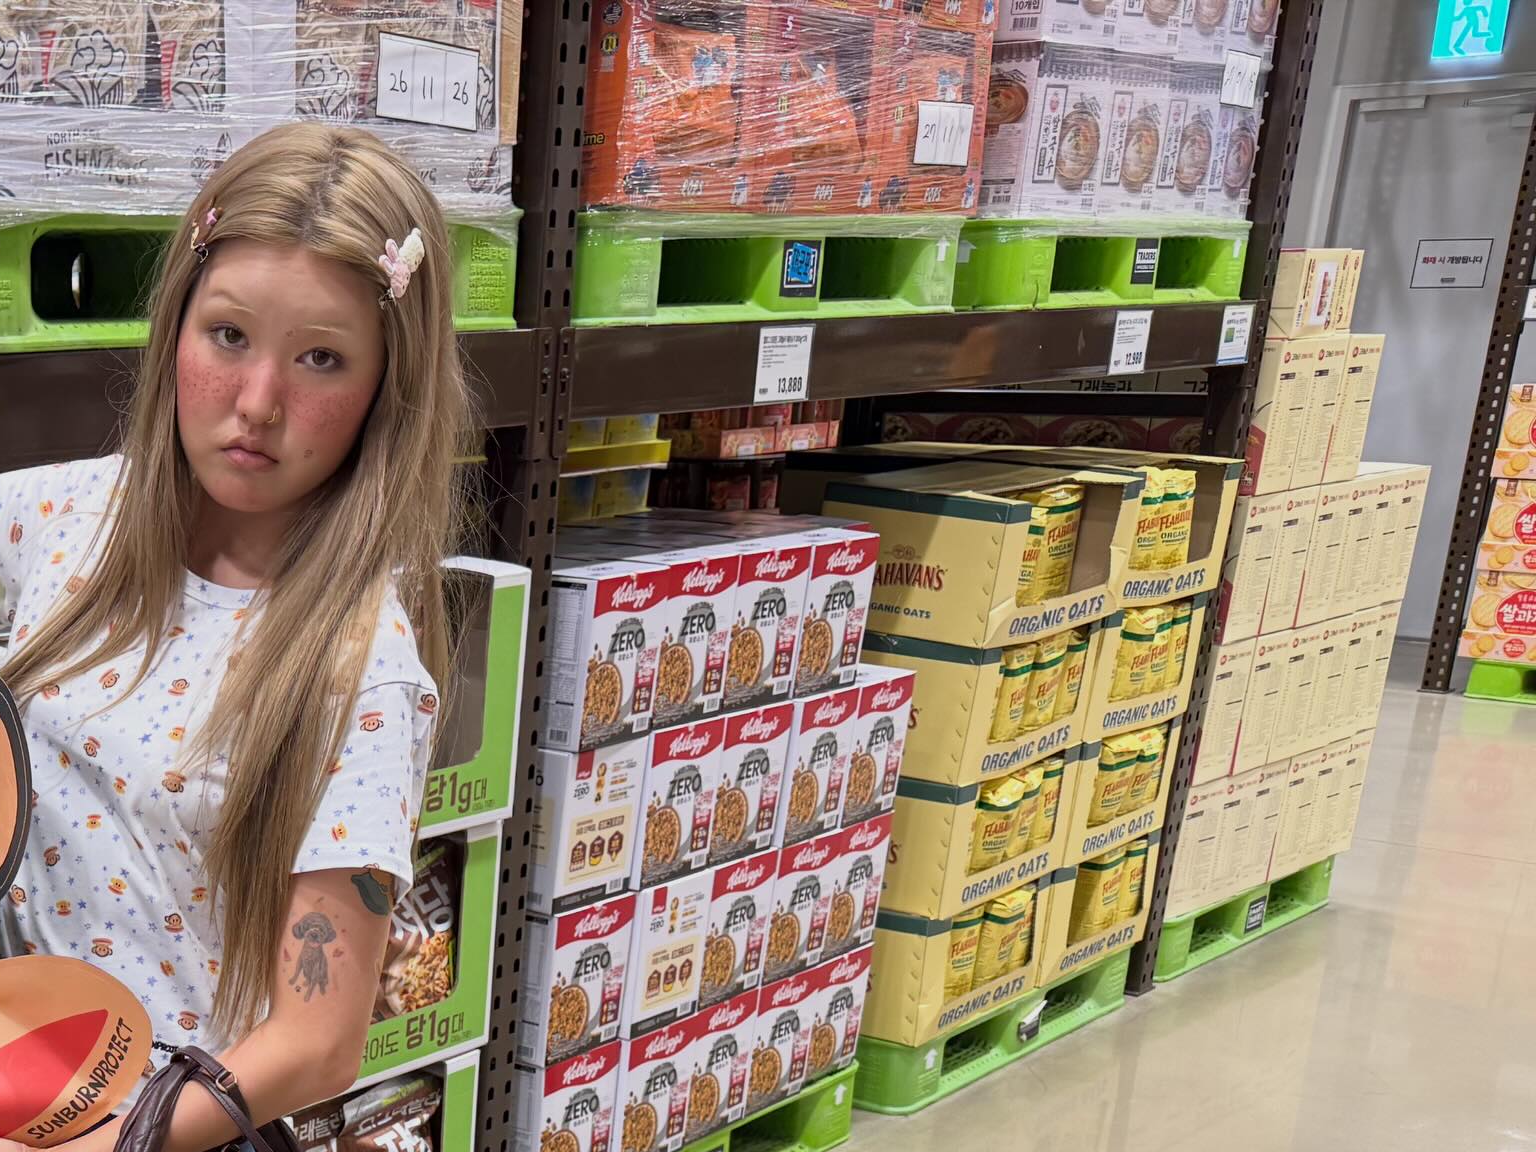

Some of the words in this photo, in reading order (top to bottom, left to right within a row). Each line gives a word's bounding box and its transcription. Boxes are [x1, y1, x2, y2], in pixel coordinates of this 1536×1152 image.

[389, 70, 408, 94] 26
[452, 80, 470, 105] 26
[1447, 256, 1483, 264] 개방됩니다
[778, 376, 802, 393] 13,880
[756, 552, 795, 579] Kellogg's
[827, 548, 864, 571] Kellogg's
[682, 566, 725, 592] Kellogg's
[873, 564, 948, 591] AHAVAN'S
[1122, 578, 1173, 597] ORGANIC
[1175, 568, 1205, 591] OATS
[612, 581, 655, 608] Kellogg's
[825, 588, 855, 613] ZERO
[751, 596, 787, 622] ZERO
[869, 601, 901, 615] GANIC
[903, 607, 931, 620] OATS
[1008, 607, 1065, 636] ORGANIC
[1068, 594, 1105, 623] OATS
[680, 611, 715, 637] ZERO
[610, 626, 645, 654] ZERO
[813, 698, 848, 725] Kellogg's
[871, 687, 904, 710] Kellogg's
[1103, 704, 1149, 729] ORGANIC
[1151, 695, 1177, 717] OATS
[740, 714, 779, 740] Kellogg's
[868, 723, 895, 748] ZERO
[670, 728, 711, 756] Kellogg's
[812, 739, 838, 764] ZERO
[981, 744, 1032, 772] ORGANIC
[1037, 725, 1070, 752] OATS
[738, 754, 770, 782] ZERO
[668, 772, 702, 800] ZERO
[849, 823, 883, 847] Kellogg's
[1082, 826, 1126, 855] ORGANIC
[1127, 810, 1155, 836] OATS
[793, 841, 831, 868] Kellogg's
[726, 862, 765, 889] Kellogg's
[848, 860, 873, 884] ZERO
[962, 869, 1014, 903] ORGANIC
[1017, 852, 1049, 881] OATS
[790, 882, 821, 907] ZERO
[575, 907, 621, 937] Kellogg's
[726, 901, 756, 928] ZERO
[1060, 941, 1105, 971] ORGANIC
[1107, 924, 1135, 948] OATS
[575, 950, 611, 979] ZERO
[829, 959, 861, 983] Kellogg's
[771, 980, 808, 1006] Kellogg's
[828, 995, 854, 1017] ZERO
[938, 991, 990, 1029] ORGANIC
[993, 975, 1025, 1003] OATS
[709, 1004, 745, 1030] Kellogg's
[771, 1016, 801, 1040] ZERO
[646, 1030, 684, 1058] Kellogg's
[708, 1041, 738, 1066] ZERO
[27, 1016, 133, 1139] SUNBURNPROJECT
[563, 1055, 607, 1084] Kellogg's
[645, 1070, 678, 1095] ZERO
[564, 1093, 599, 1121] ZERO
